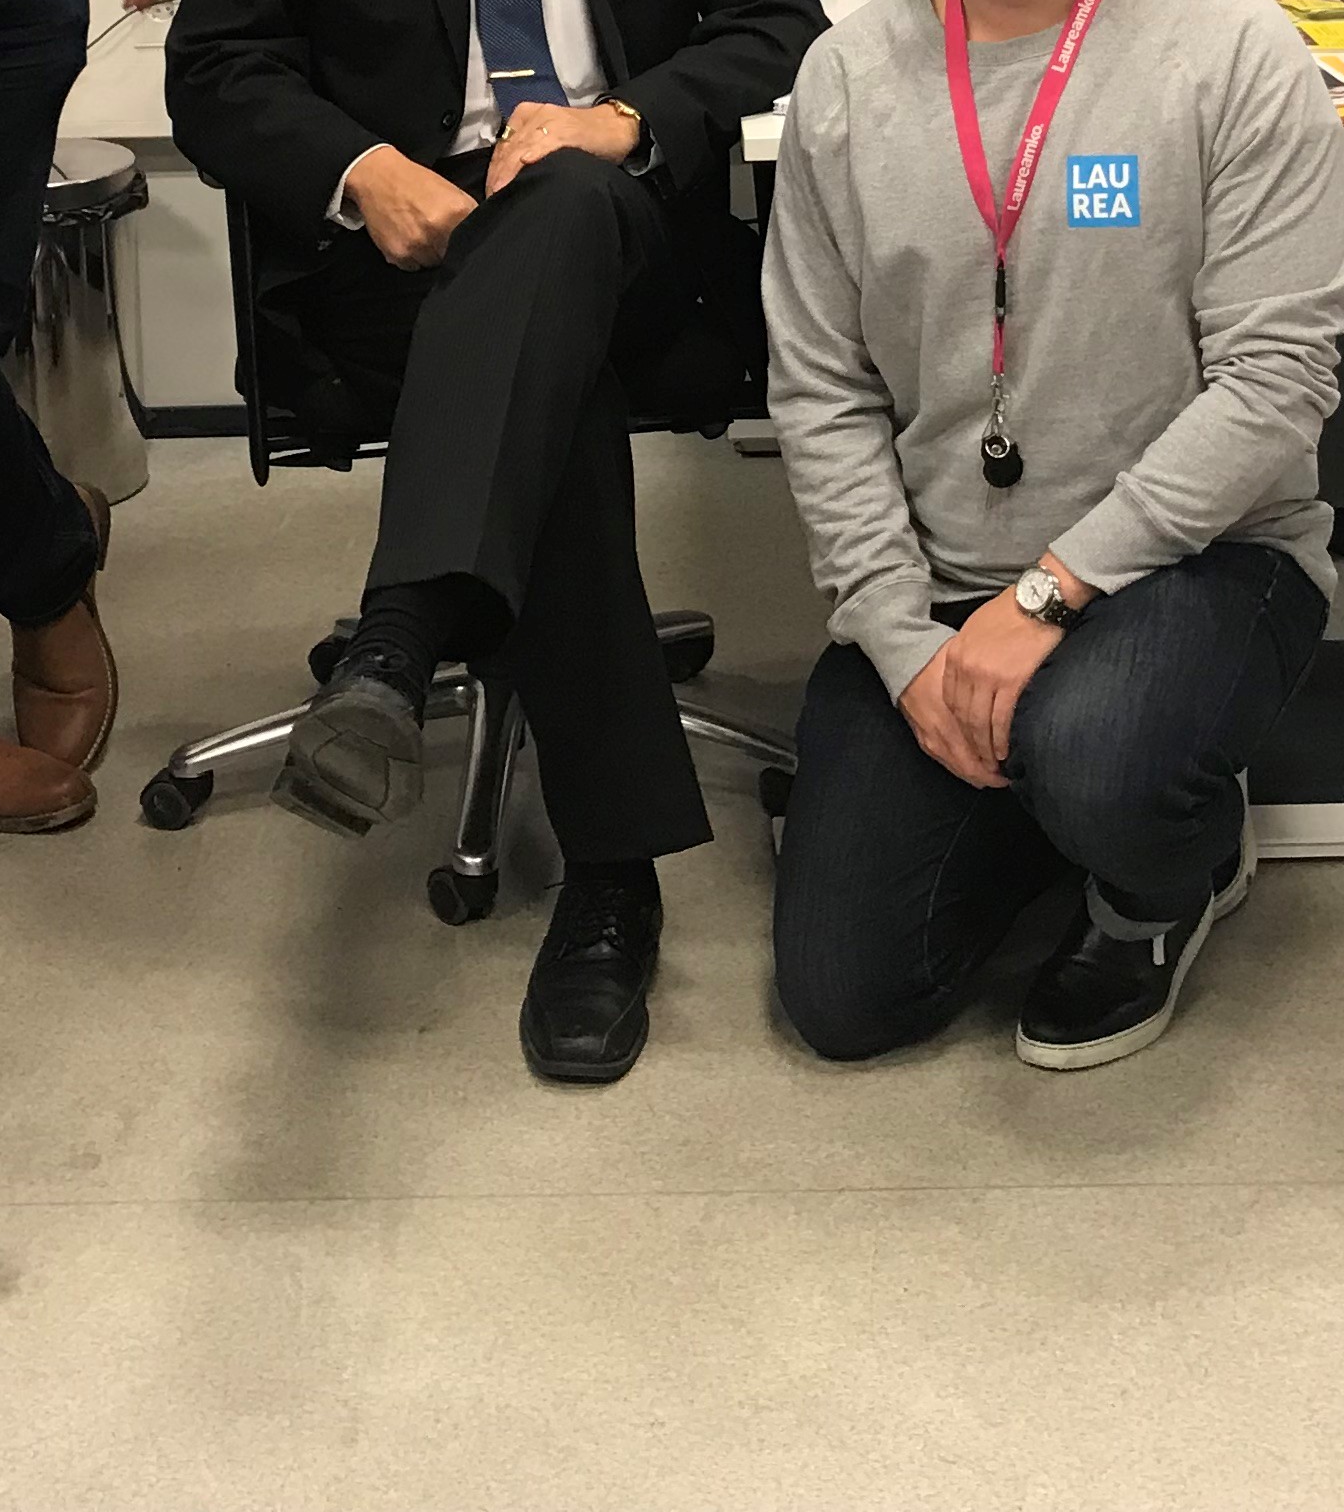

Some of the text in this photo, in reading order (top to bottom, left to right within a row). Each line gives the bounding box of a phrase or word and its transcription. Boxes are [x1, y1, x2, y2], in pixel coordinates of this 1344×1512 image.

[1007, 123, 1045, 212] Laureamko.
[1073, 163, 1129, 189] LAU
[1073, 192, 1132, 219] REA
